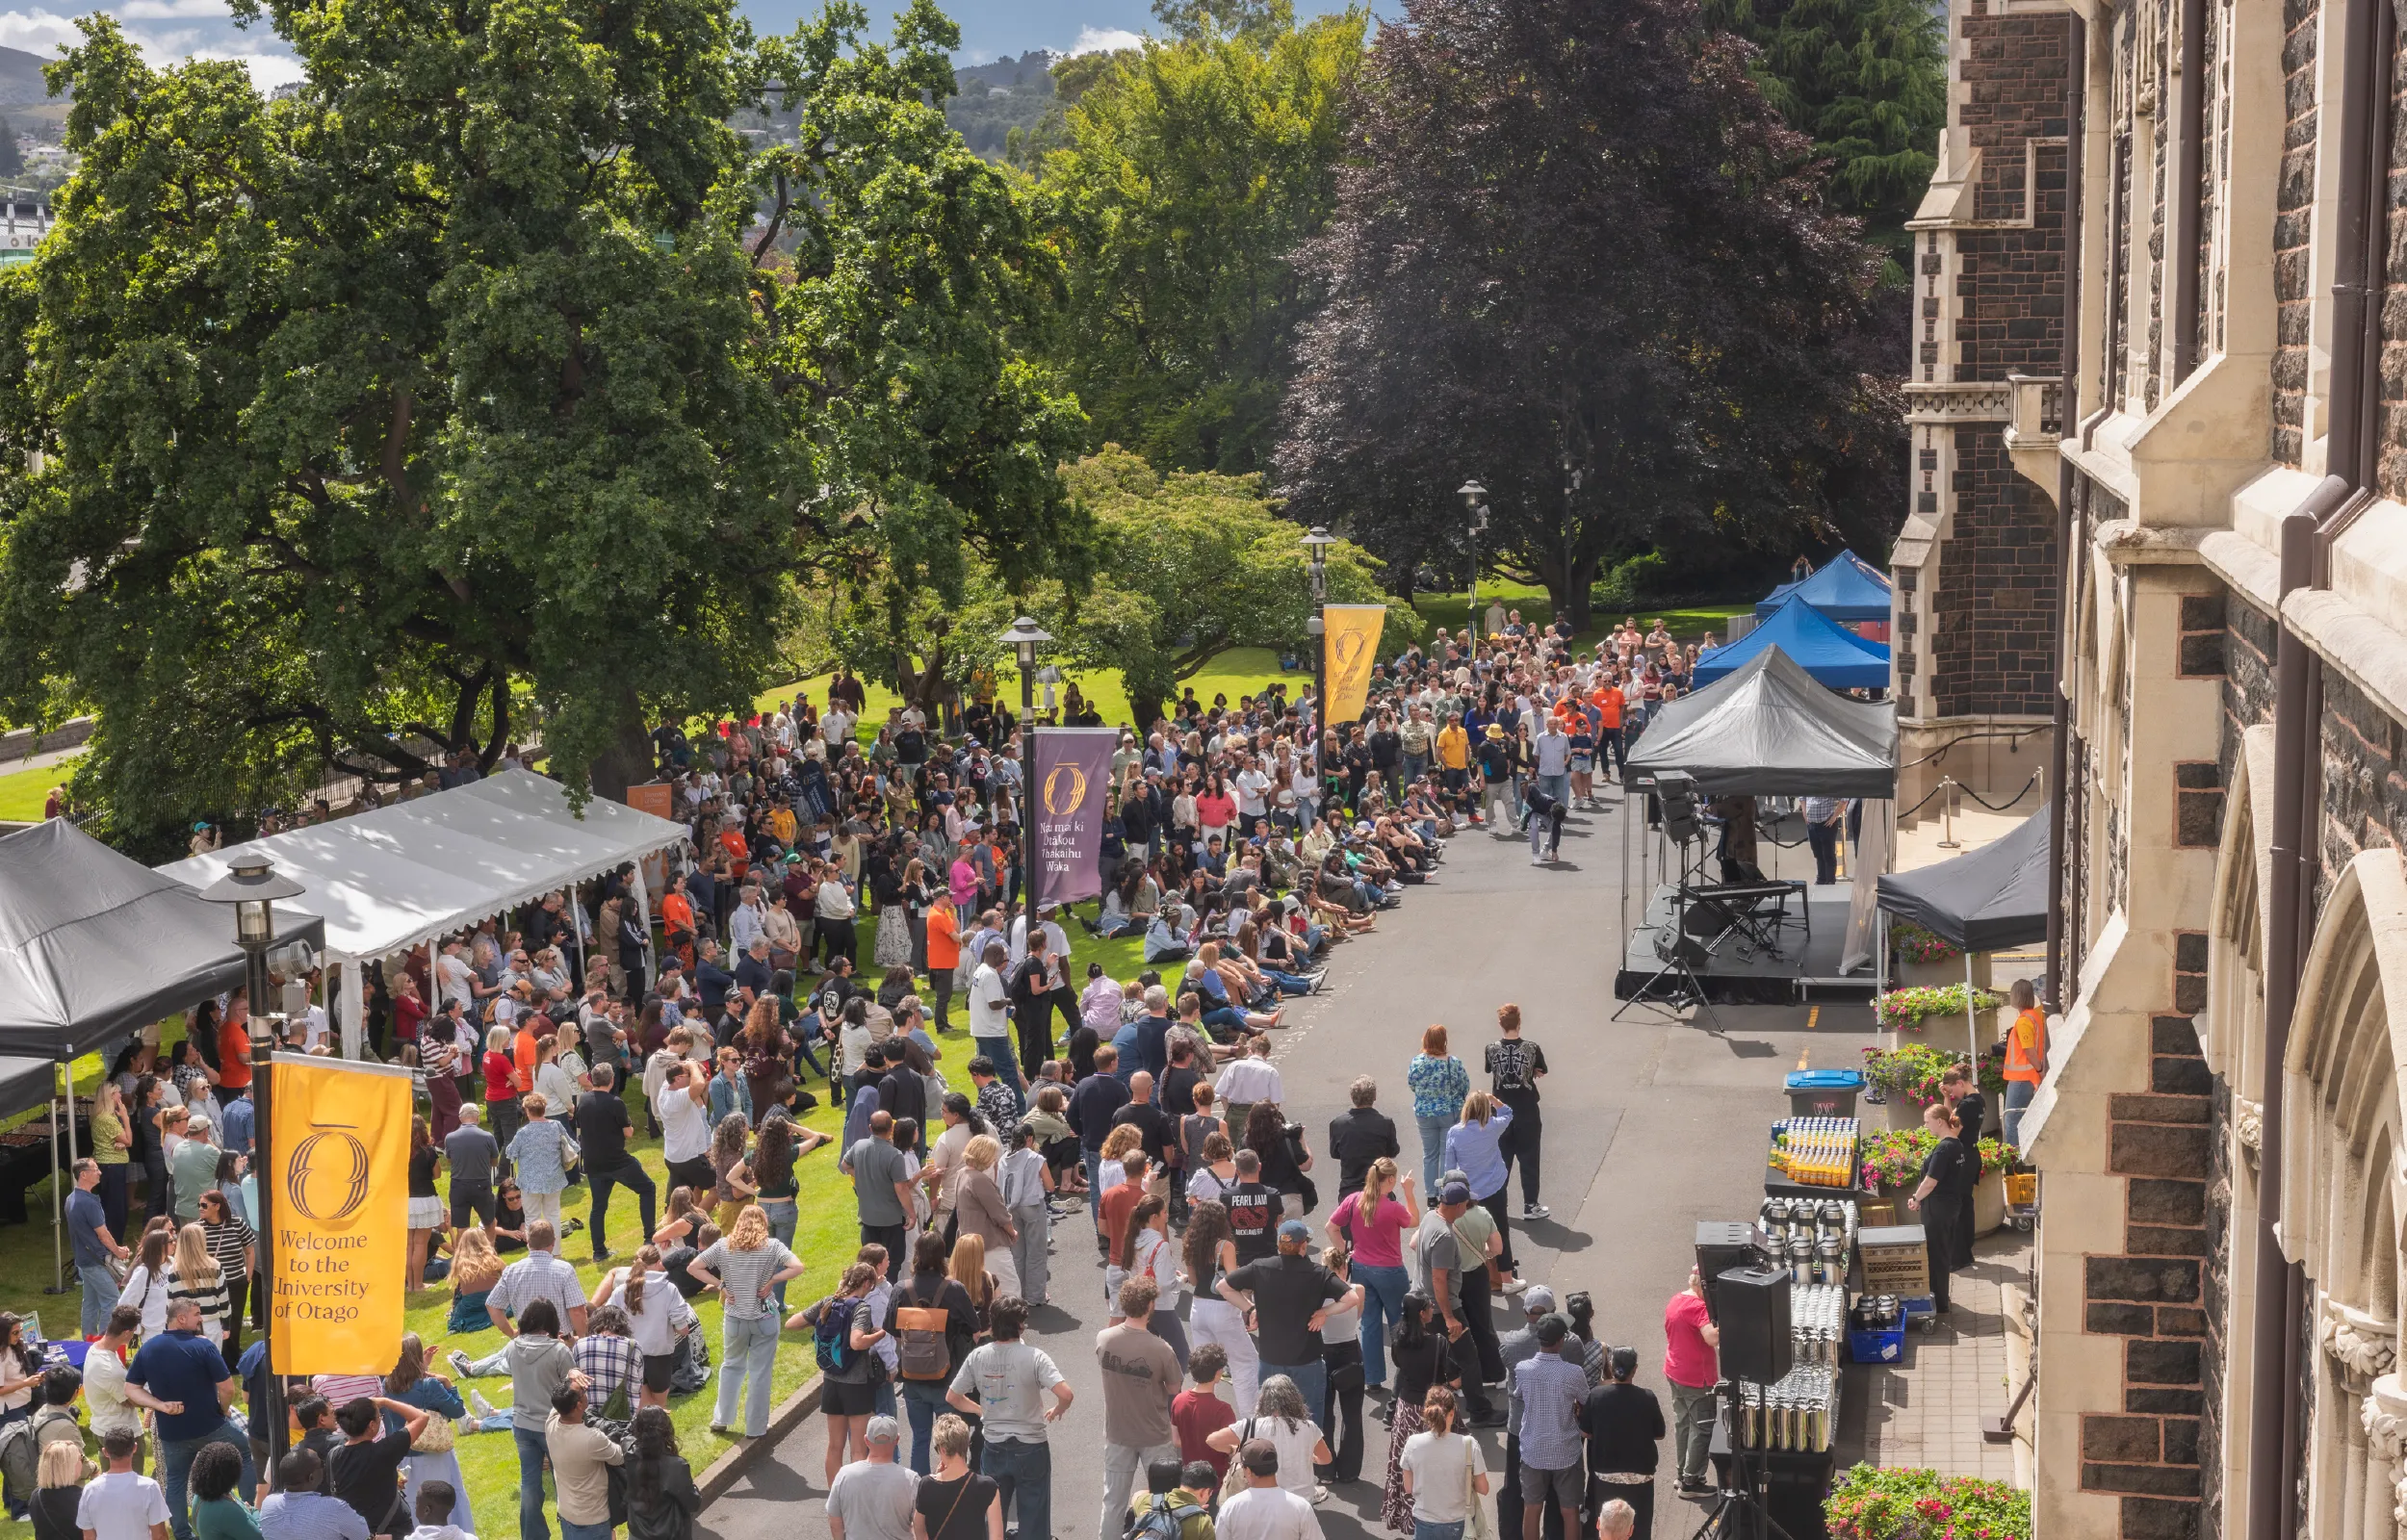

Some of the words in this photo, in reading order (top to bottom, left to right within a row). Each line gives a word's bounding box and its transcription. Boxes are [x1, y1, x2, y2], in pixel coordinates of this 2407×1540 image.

[1054, 821, 1072, 833] mai
[1074, 820, 1084, 833] ki
[1046, 860, 1070, 872] Waka
[1231, 1194, 1253, 1207] PEARL
[1254, 1194, 1268, 1206] JAM
[280, 1229, 368, 1250] Welcome
[290, 1257, 310, 1272] to
[316, 1255, 349, 1273] the
[272, 1275, 370, 1299] University
[274, 1300, 294, 1319] of
[297, 1301, 359, 1323] Otago
